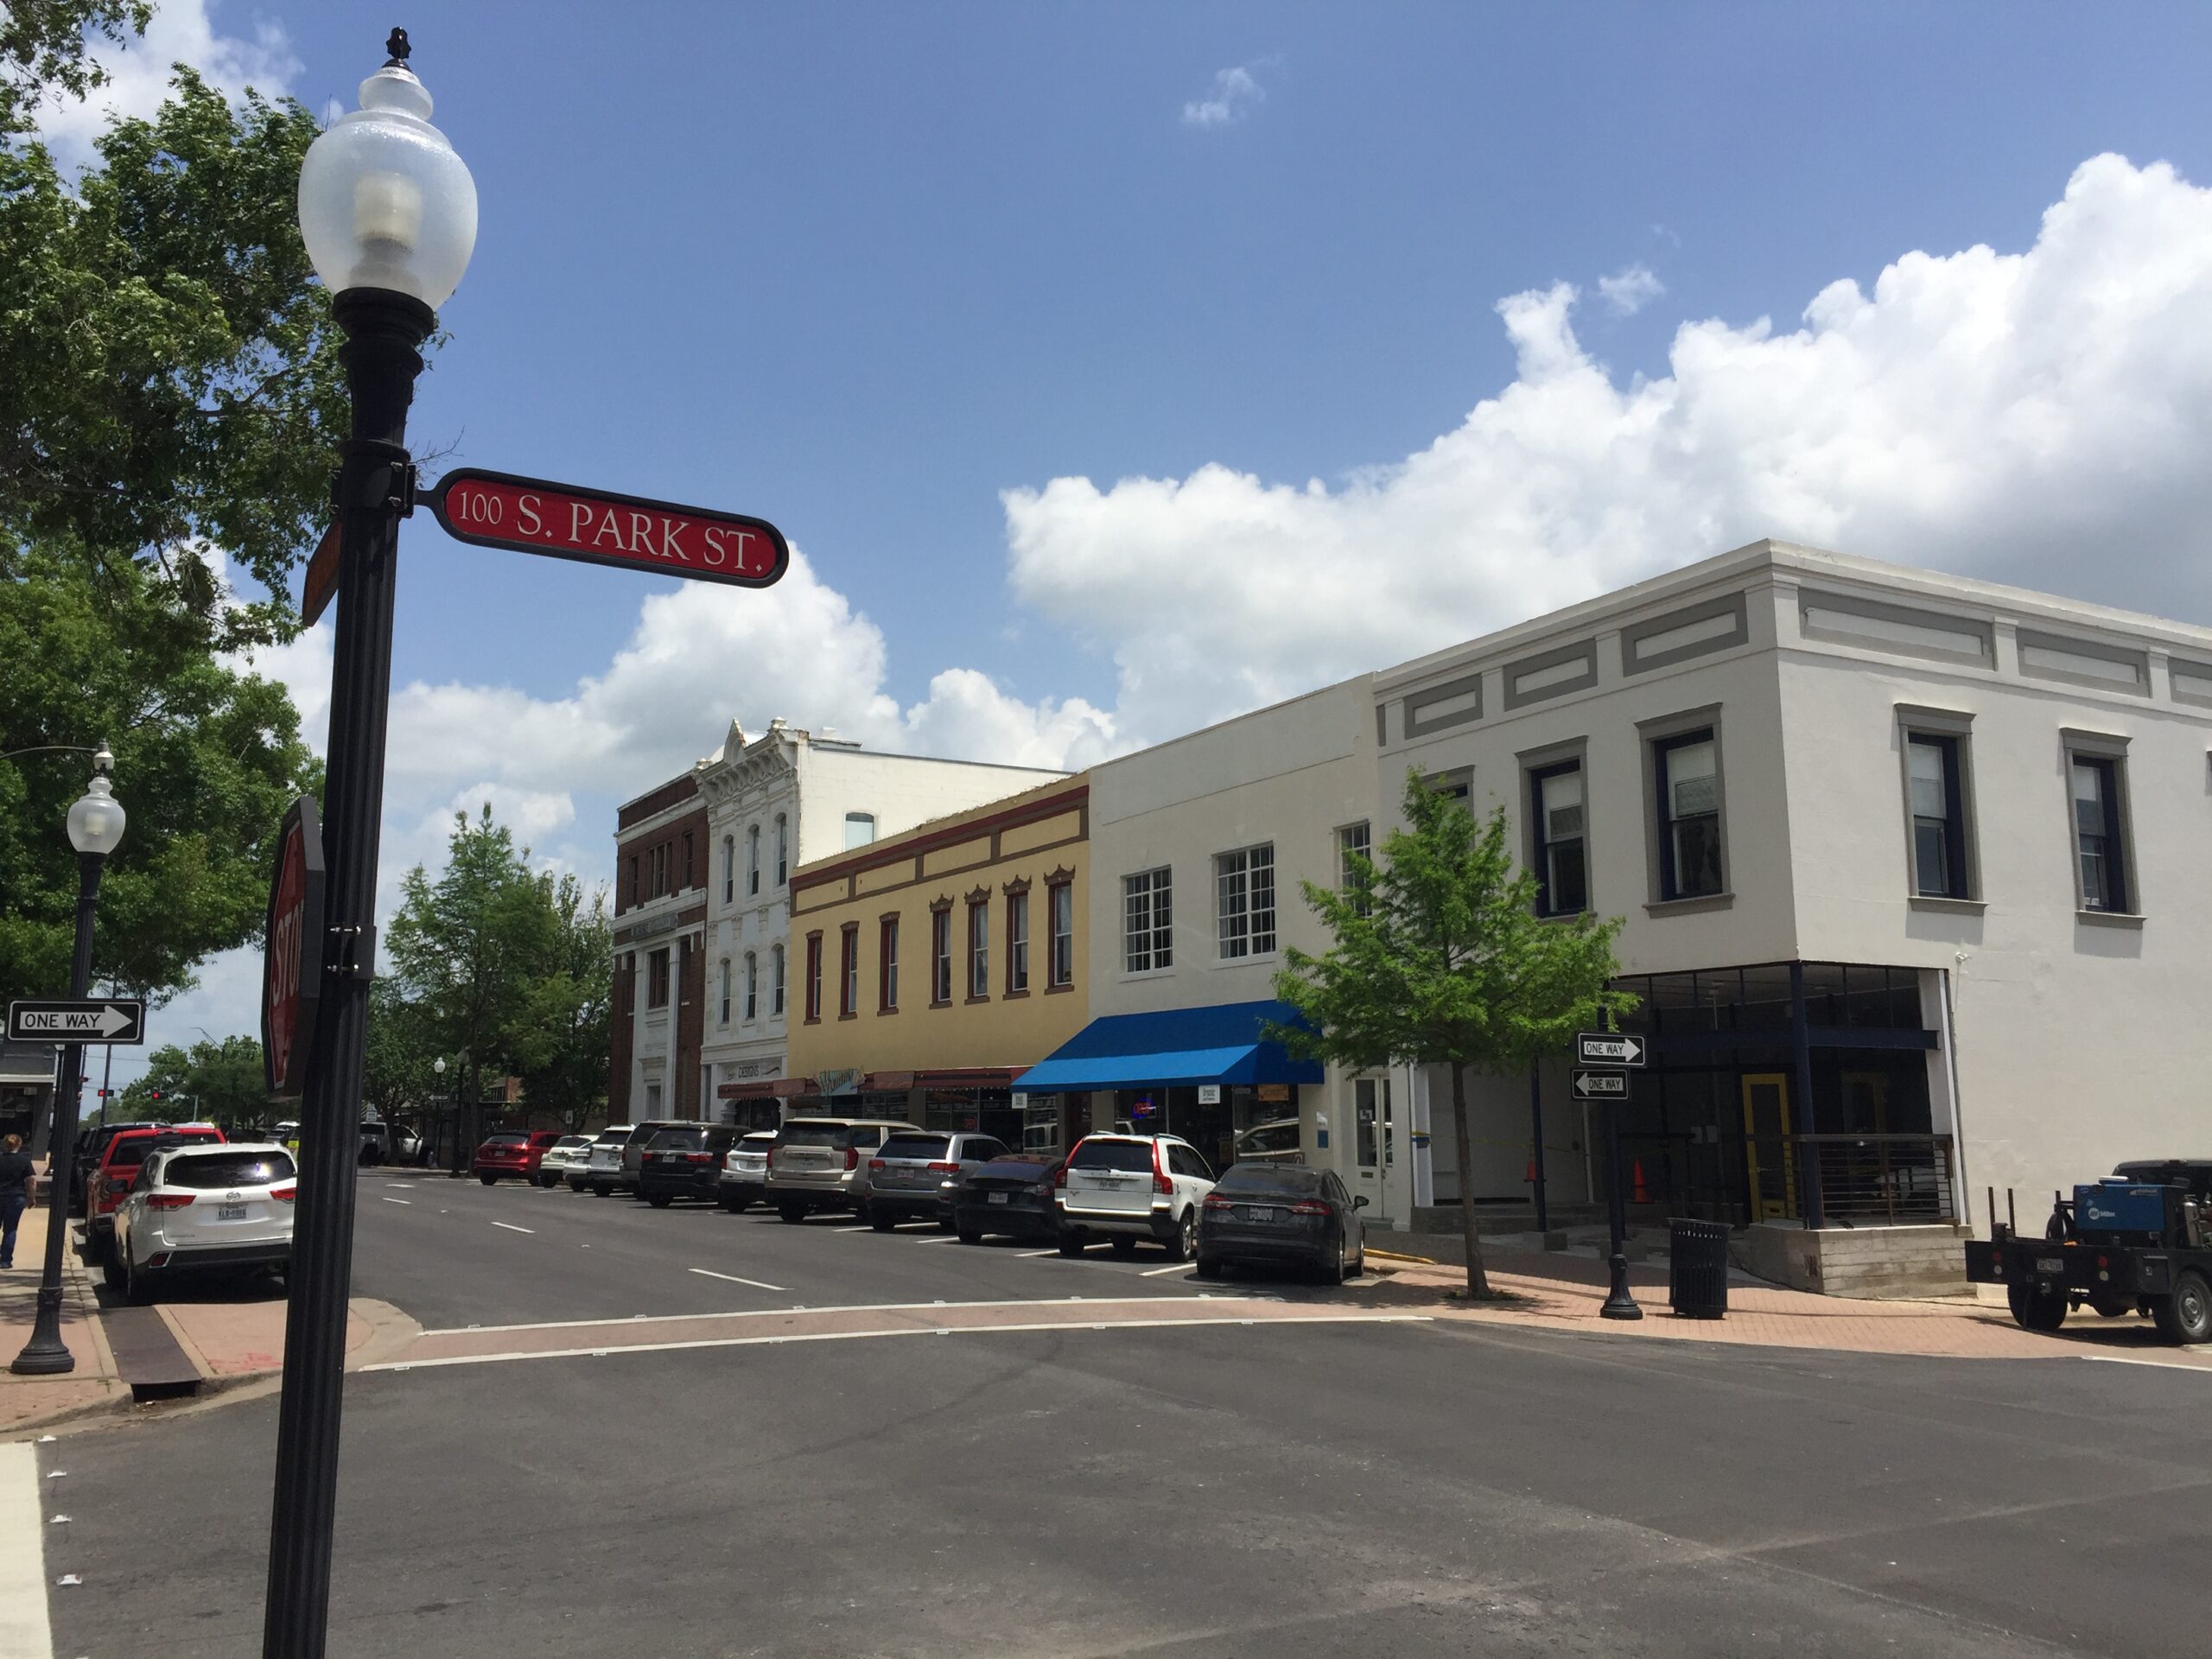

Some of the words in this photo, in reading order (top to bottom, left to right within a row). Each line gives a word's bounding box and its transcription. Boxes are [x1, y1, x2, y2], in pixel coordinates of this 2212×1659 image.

[460, 490, 502, 525] 100
[517, 494, 553, 539] S.
[568, 502, 690, 561] PARK
[703, 526, 764, 572] ST.
[24, 1014, 59, 1028] ONE
[65, 1014, 101, 1028] WAY
[1586, 1043, 1604, 1054] ONE
[1605, 1044, 1624, 1055] WAY
[1588, 1078, 1604, 1090] ONE
[1605, 1078, 1621, 1090] WAY
